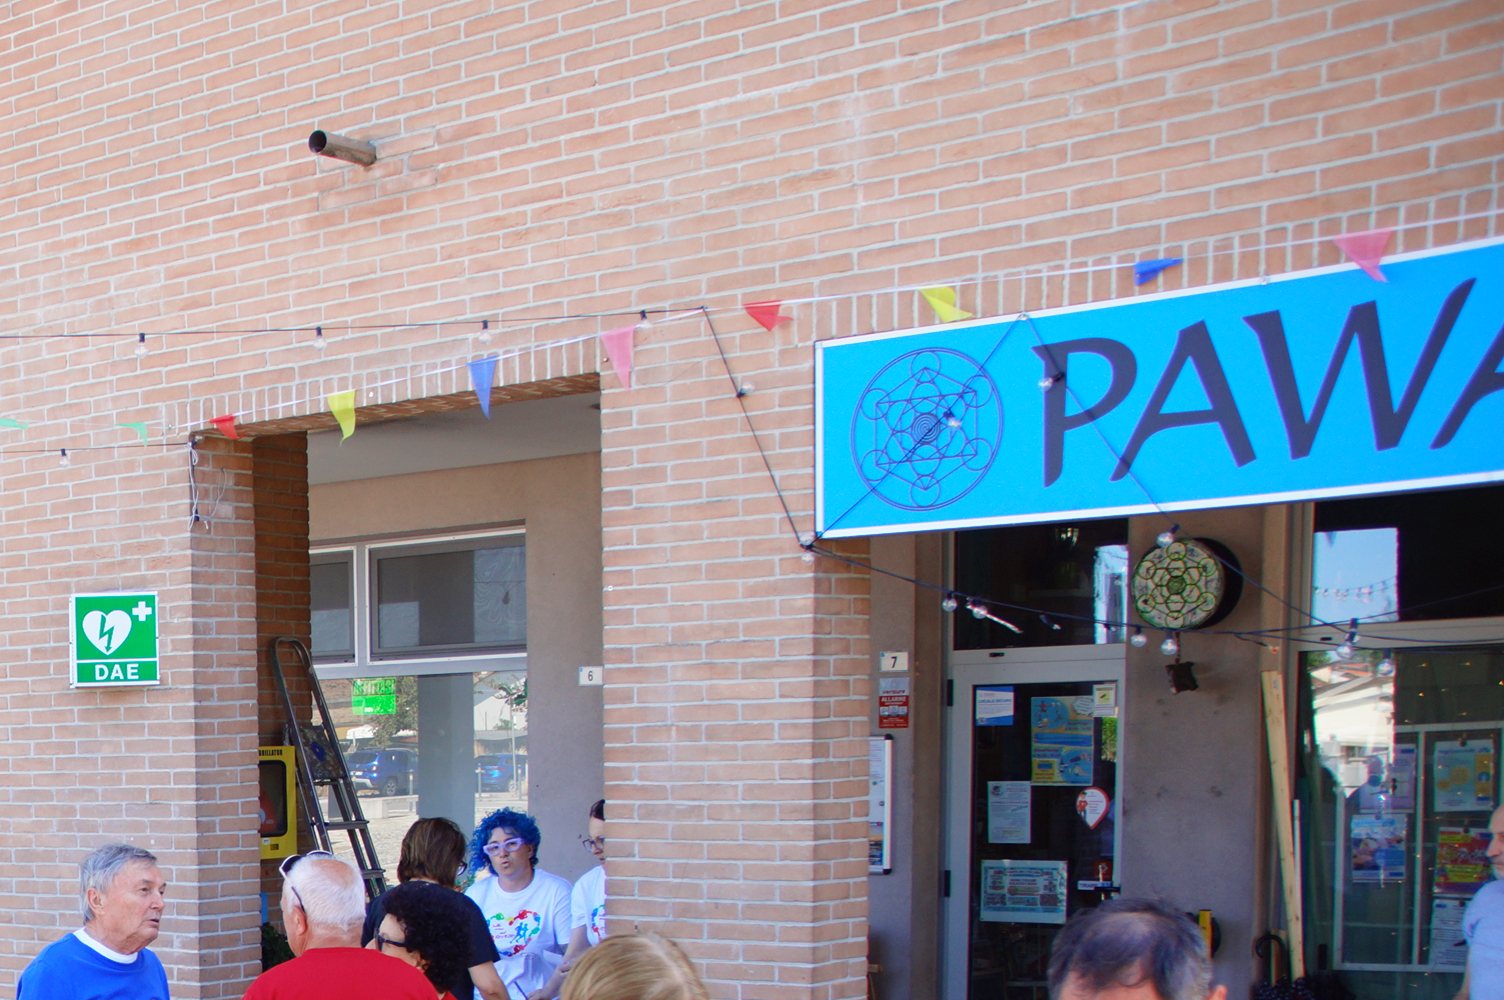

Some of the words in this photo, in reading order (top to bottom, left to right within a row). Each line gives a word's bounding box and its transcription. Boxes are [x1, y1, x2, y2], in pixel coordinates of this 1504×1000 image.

[891, 656, 897, 668] 7
[94, 663, 140, 681] DAE
[588, 670, 594, 682] 6
